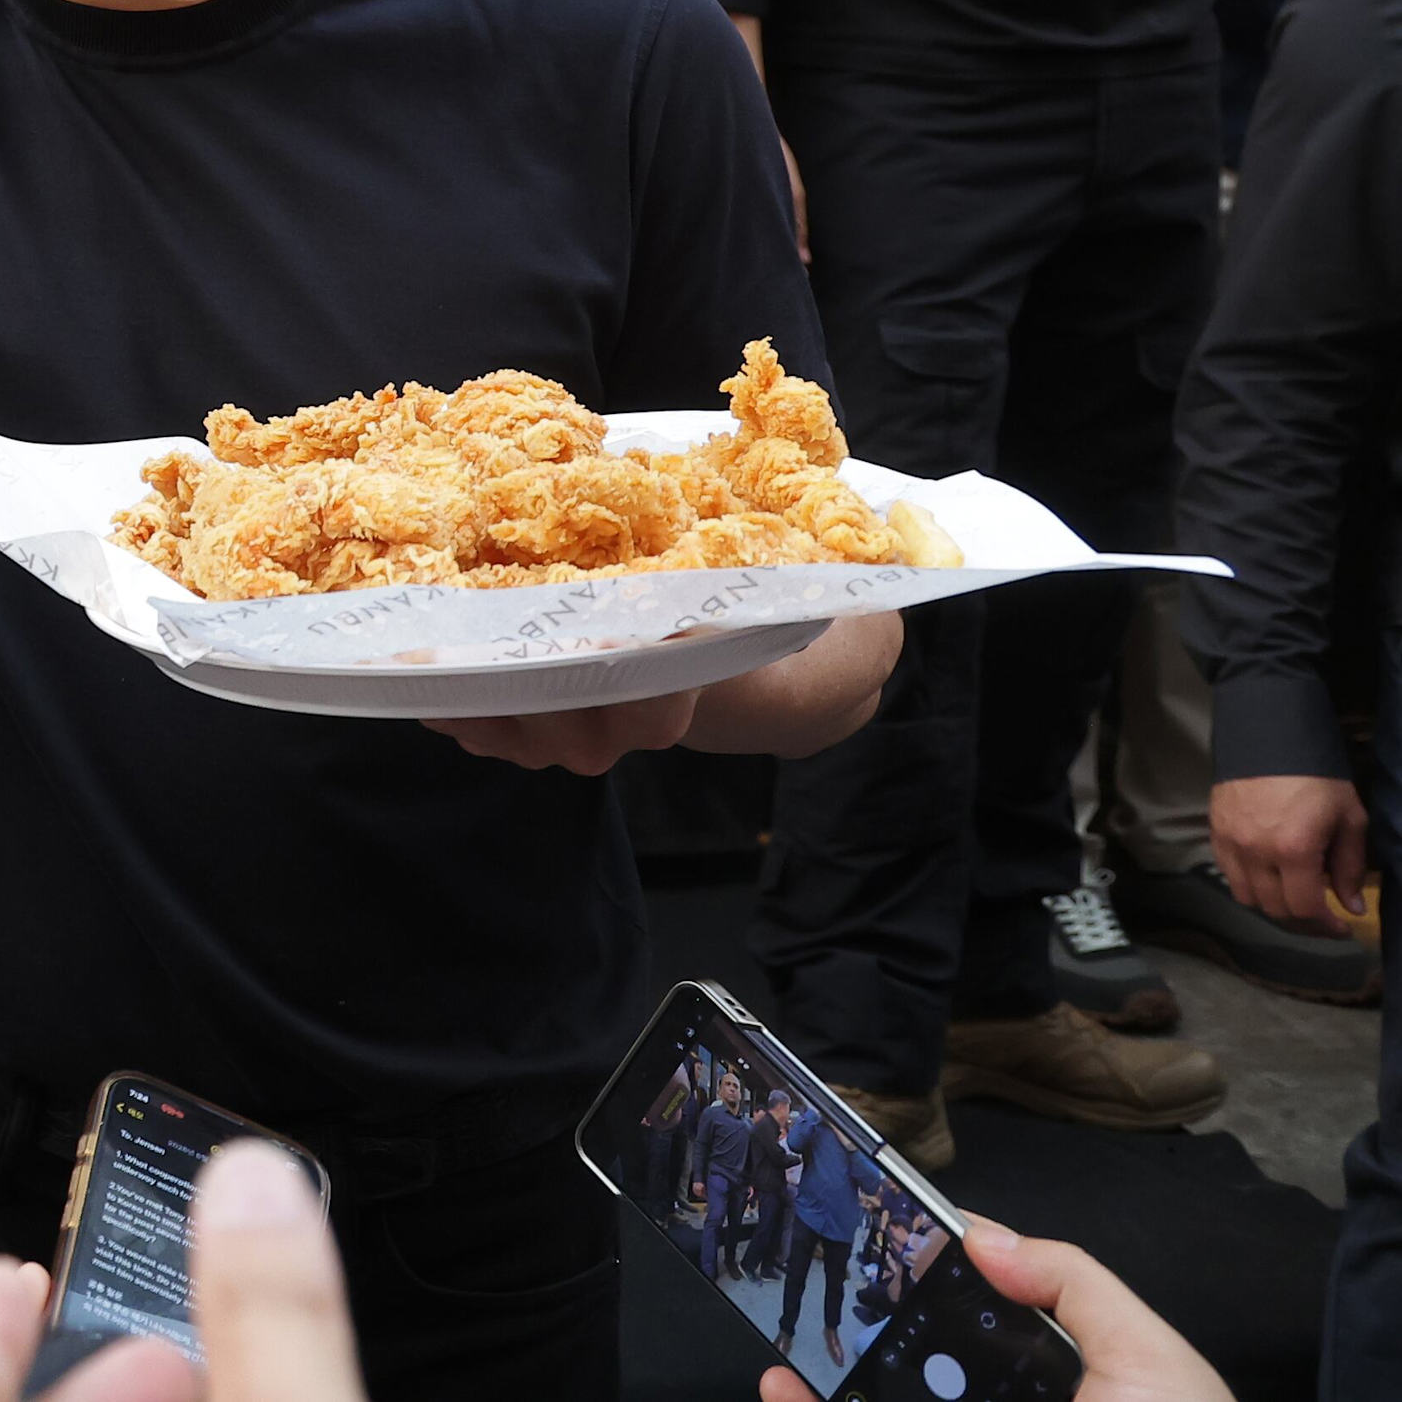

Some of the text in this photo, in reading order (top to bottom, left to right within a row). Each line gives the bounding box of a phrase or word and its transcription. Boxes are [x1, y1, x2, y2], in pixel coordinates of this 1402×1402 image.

[307, 587, 456, 637] KANBU
[133, 1136, 167, 1156] Jensen
[113, 1161, 156, 1187] underway
[124, 1153, 148, 1172] What
